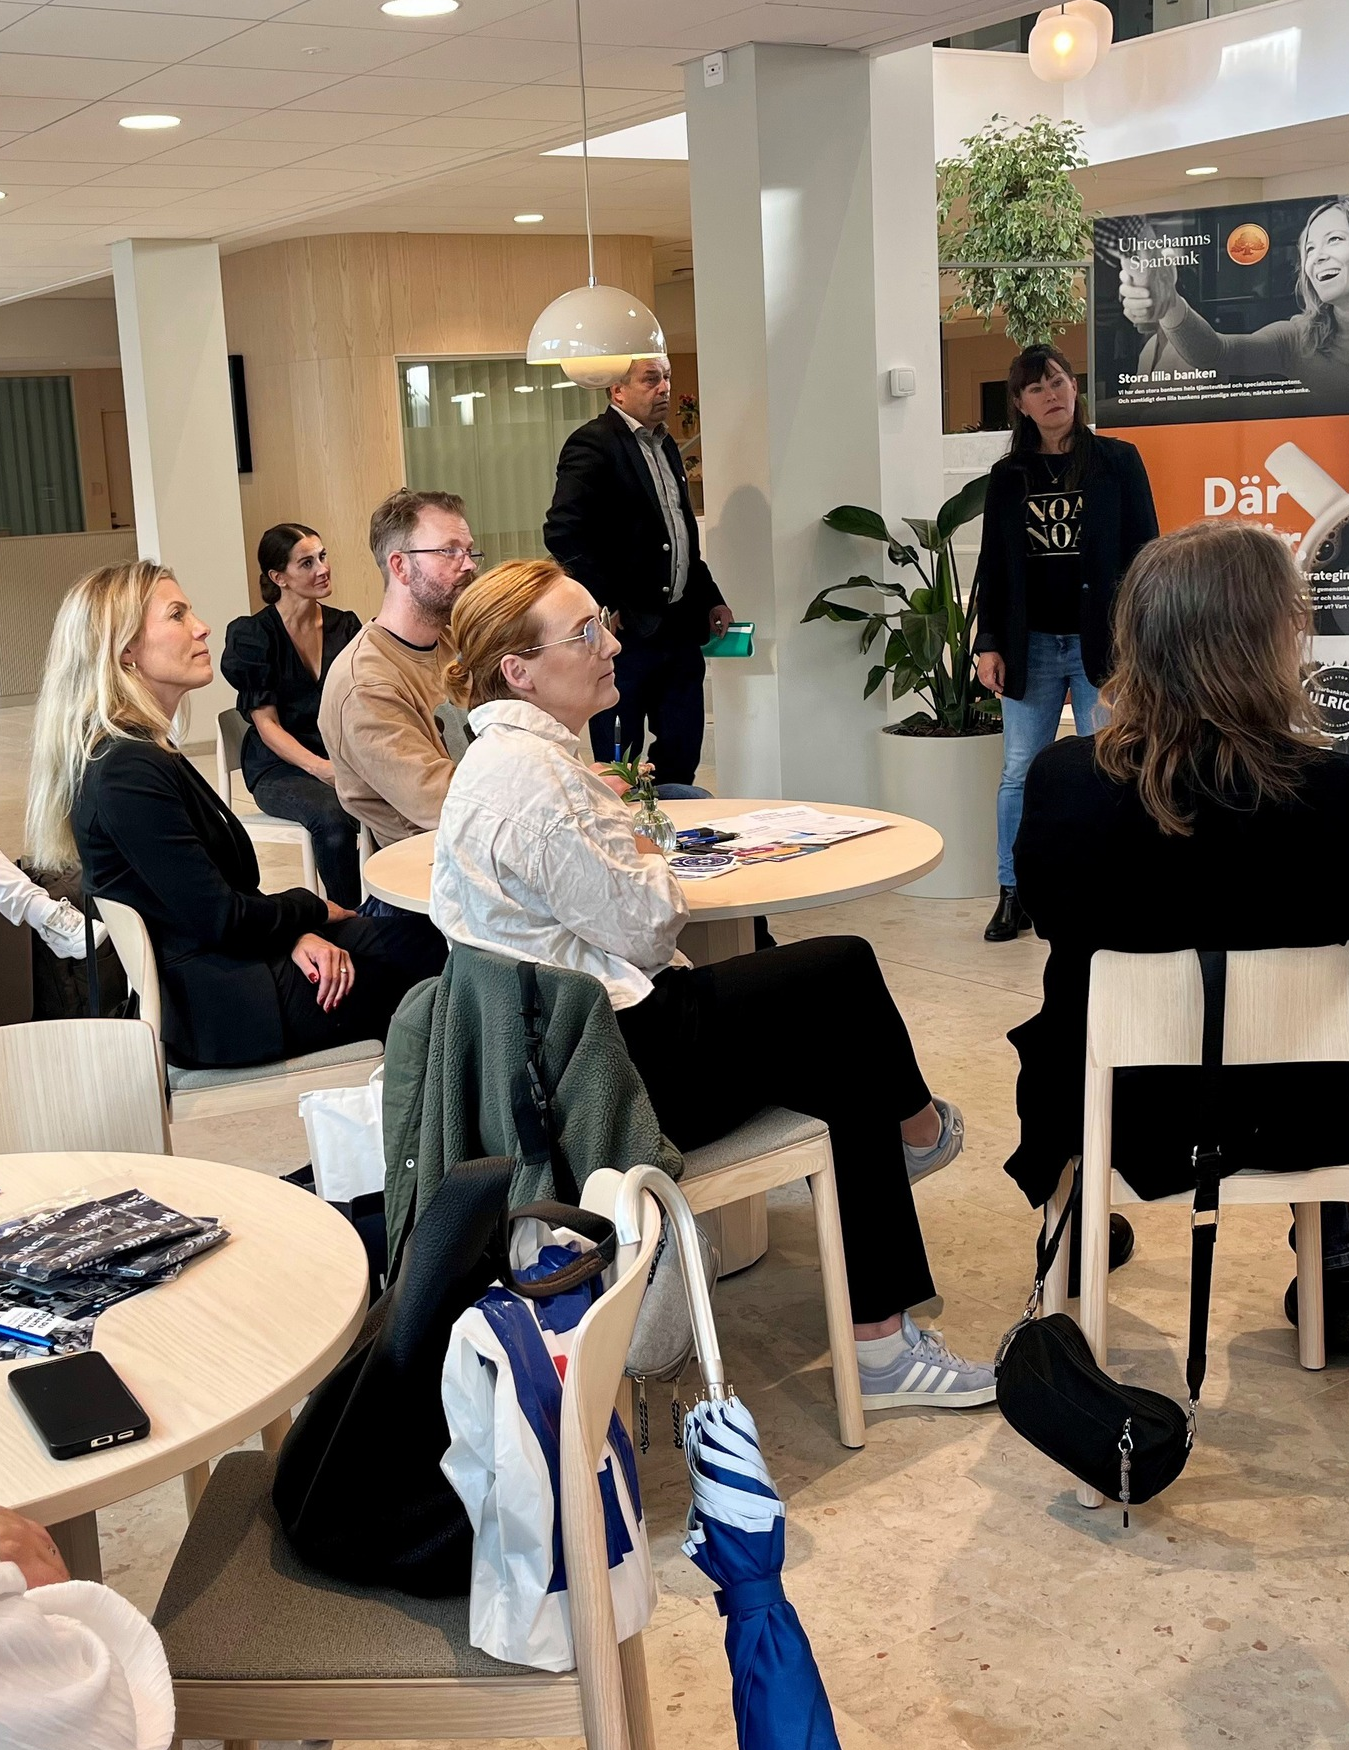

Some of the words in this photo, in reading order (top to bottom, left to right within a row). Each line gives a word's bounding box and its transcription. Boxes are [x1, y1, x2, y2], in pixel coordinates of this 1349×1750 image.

[1118, 234, 1211, 252] Ulricehamns
[1129, 250, 1200, 273] Sparbank
[1118, 373, 1148, 383] Stora
[1151, 370, 1171, 381] lilla
[1173, 368, 1216, 380] banken
[1204, 475, 1288, 516] Där
